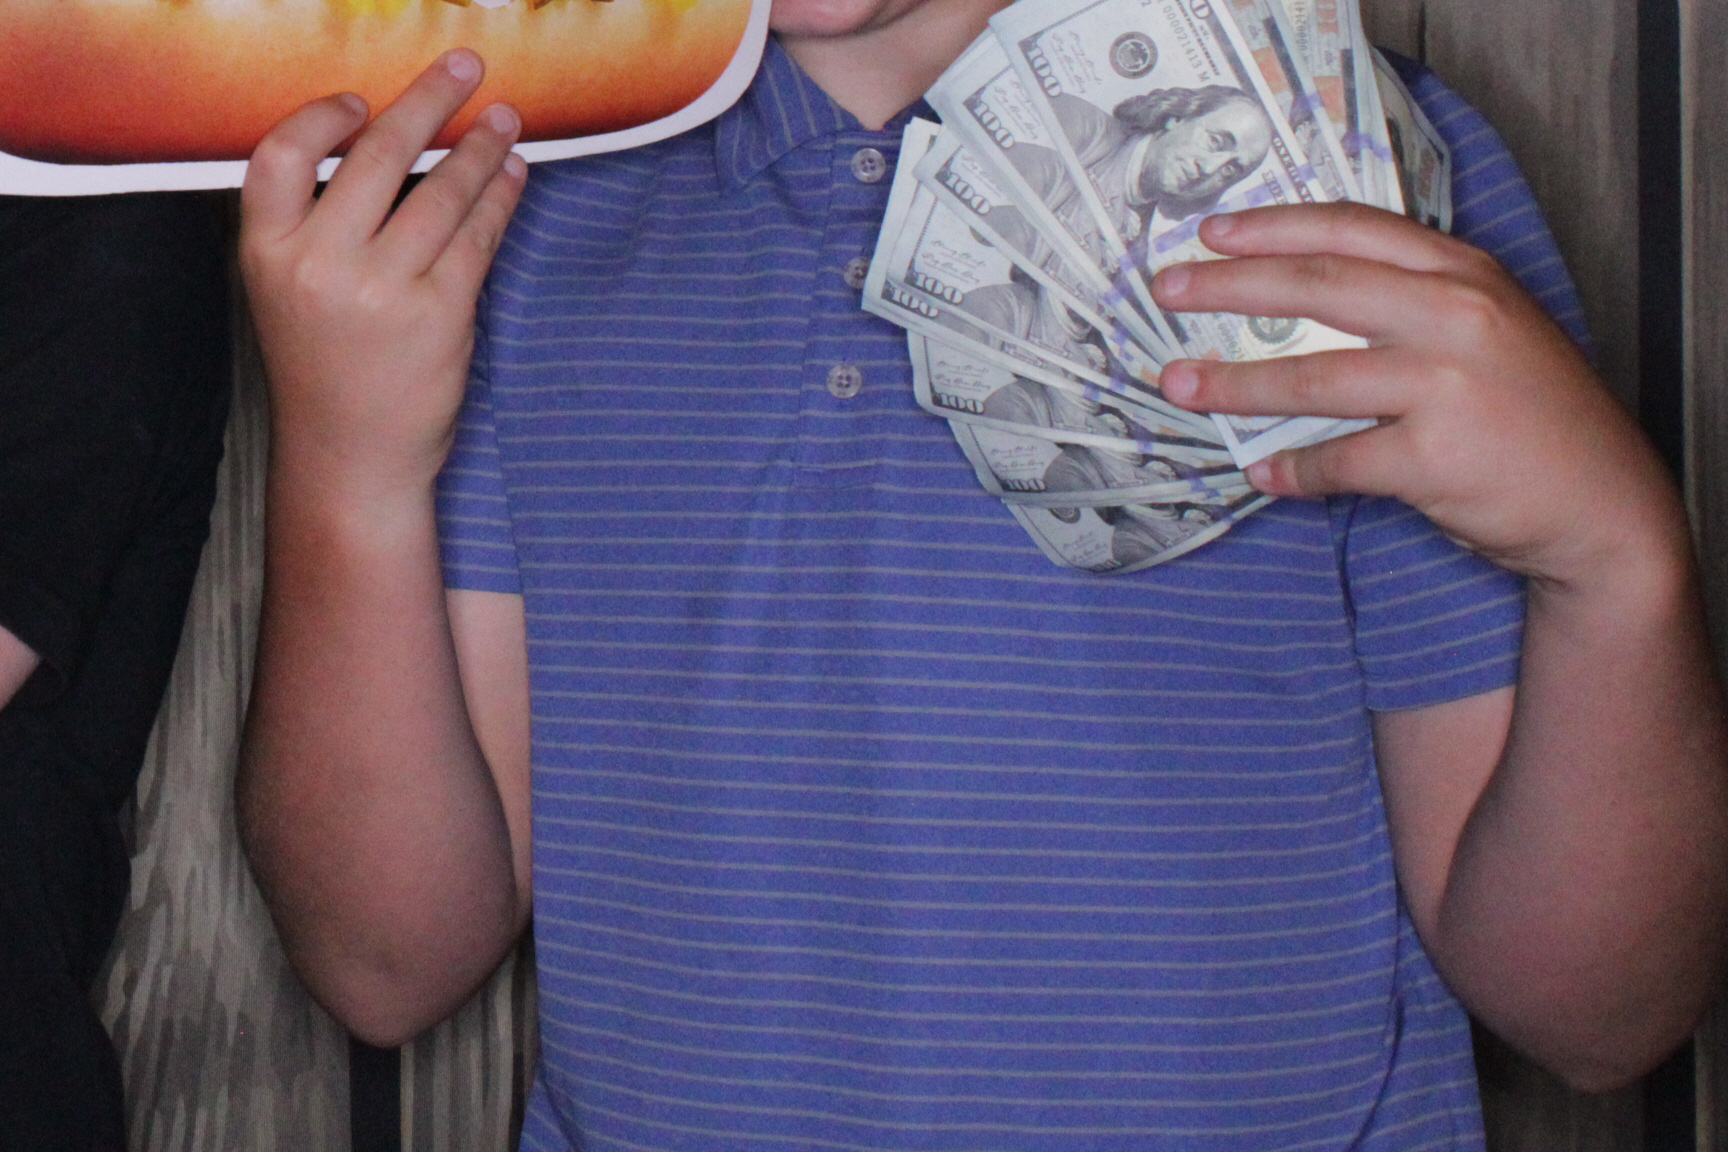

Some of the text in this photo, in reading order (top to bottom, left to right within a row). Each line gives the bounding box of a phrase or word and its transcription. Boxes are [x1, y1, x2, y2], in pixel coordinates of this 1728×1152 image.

[1162, 5, 1202, 69] 000021413
[1197, 70, 1210, 83] M
[1027, 46, 1063, 98] 100
[973, 101, 1016, 149] 100
[945, 172, 992, 215] 100
[892, 287, 940, 318] 100
[915, 271, 964, 306] 100
[939, 393, 985, 415] 100
[1004, 478, 1048, 492] 100
